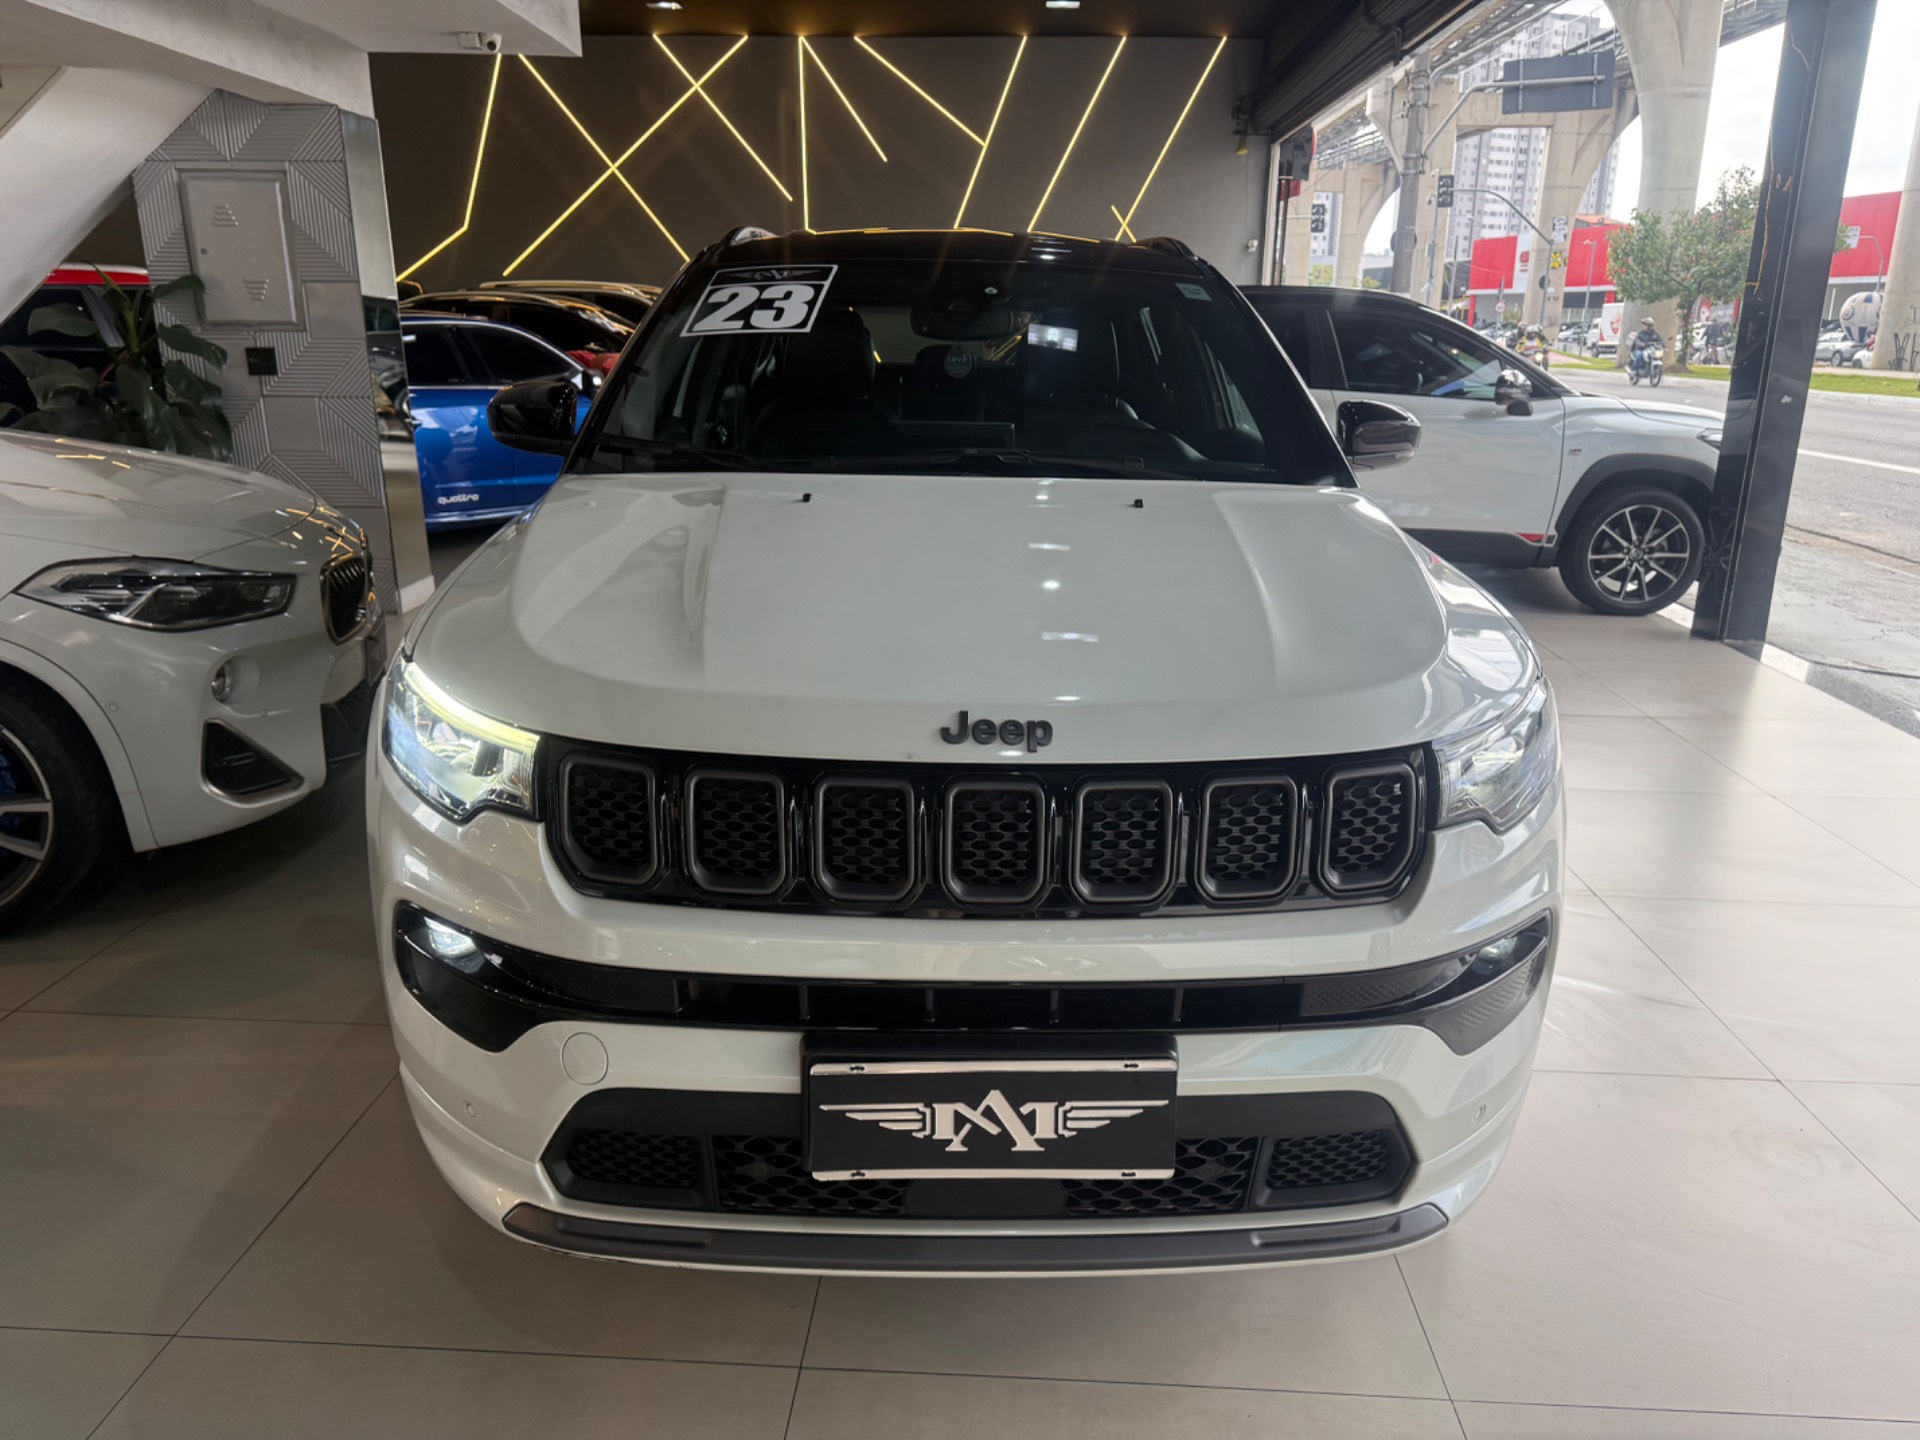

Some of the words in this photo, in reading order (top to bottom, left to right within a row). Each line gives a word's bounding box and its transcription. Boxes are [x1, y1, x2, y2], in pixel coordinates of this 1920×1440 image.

[692, 284, 815, 332] 23
[437, 493, 480, 506] quattro
[940, 710, 1053, 753] Jeep
